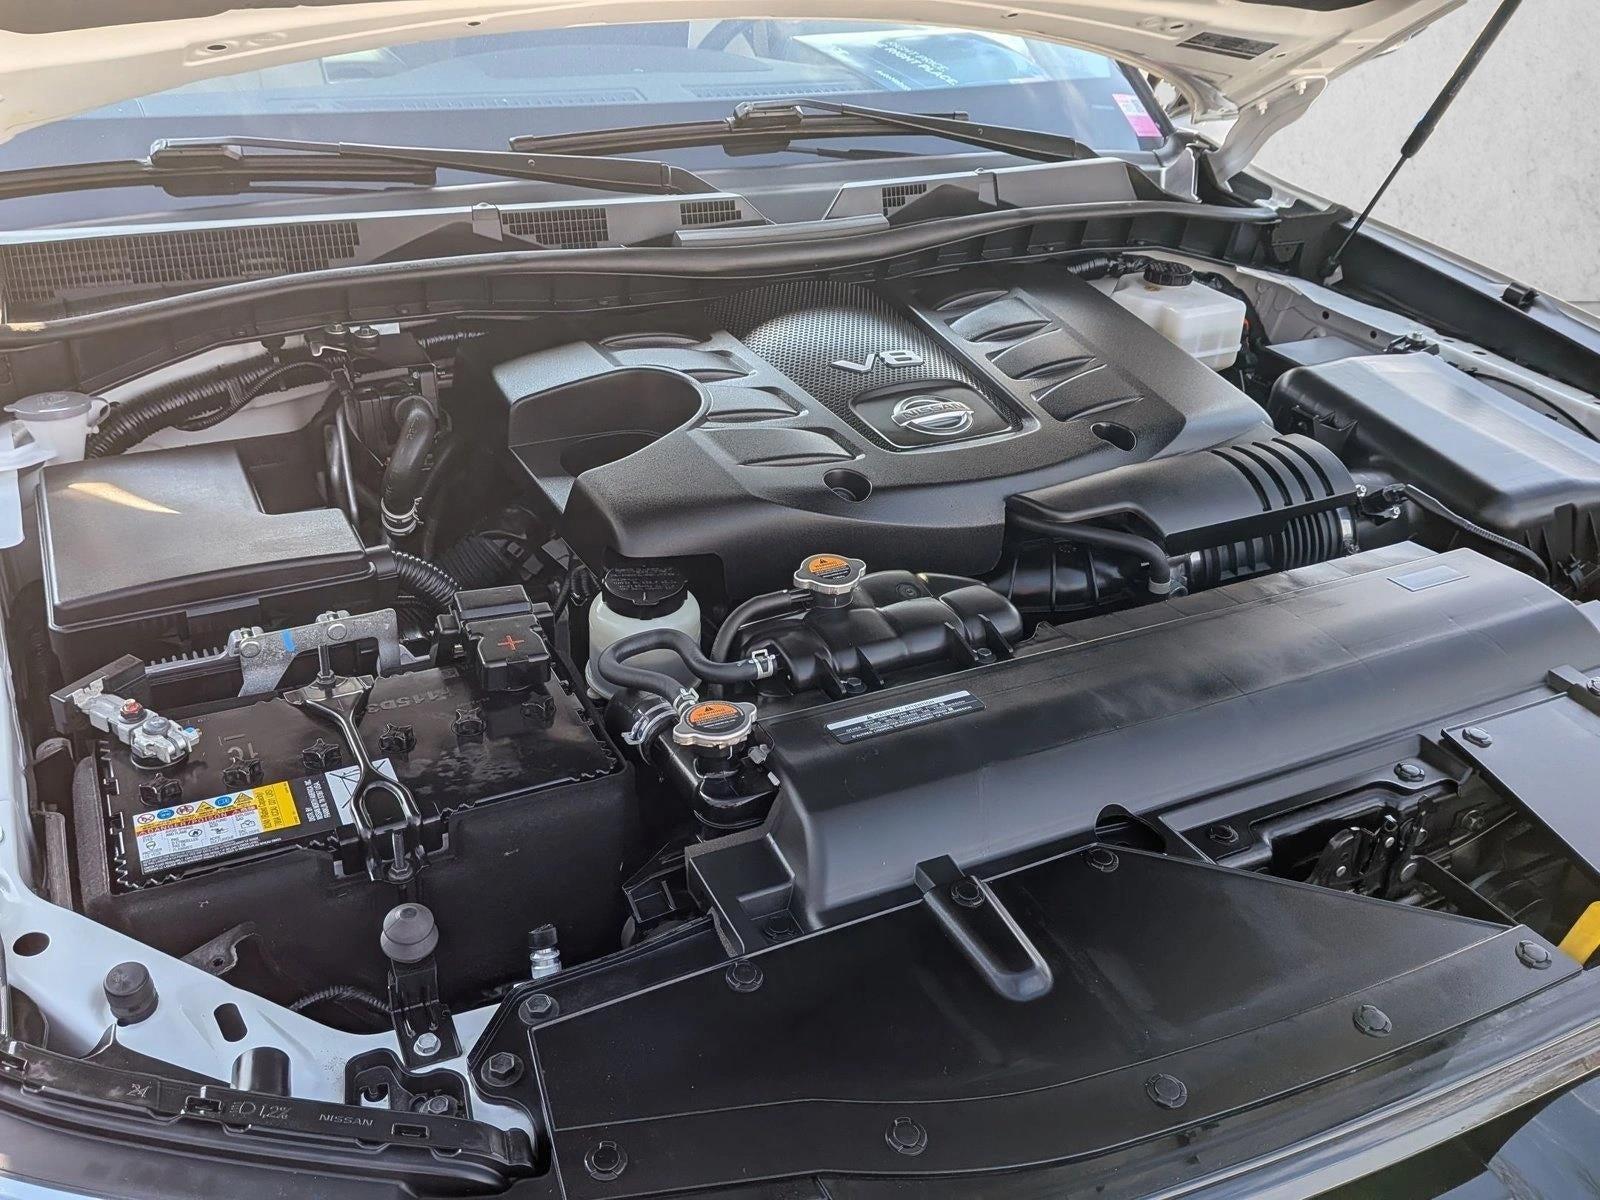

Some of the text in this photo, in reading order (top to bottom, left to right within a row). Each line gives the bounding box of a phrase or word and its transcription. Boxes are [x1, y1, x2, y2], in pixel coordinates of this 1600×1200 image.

[831, 350, 925, 373] V8
[901, 401, 969, 421] NISSAN
[318, 1112, 375, 1128] NISSAN
